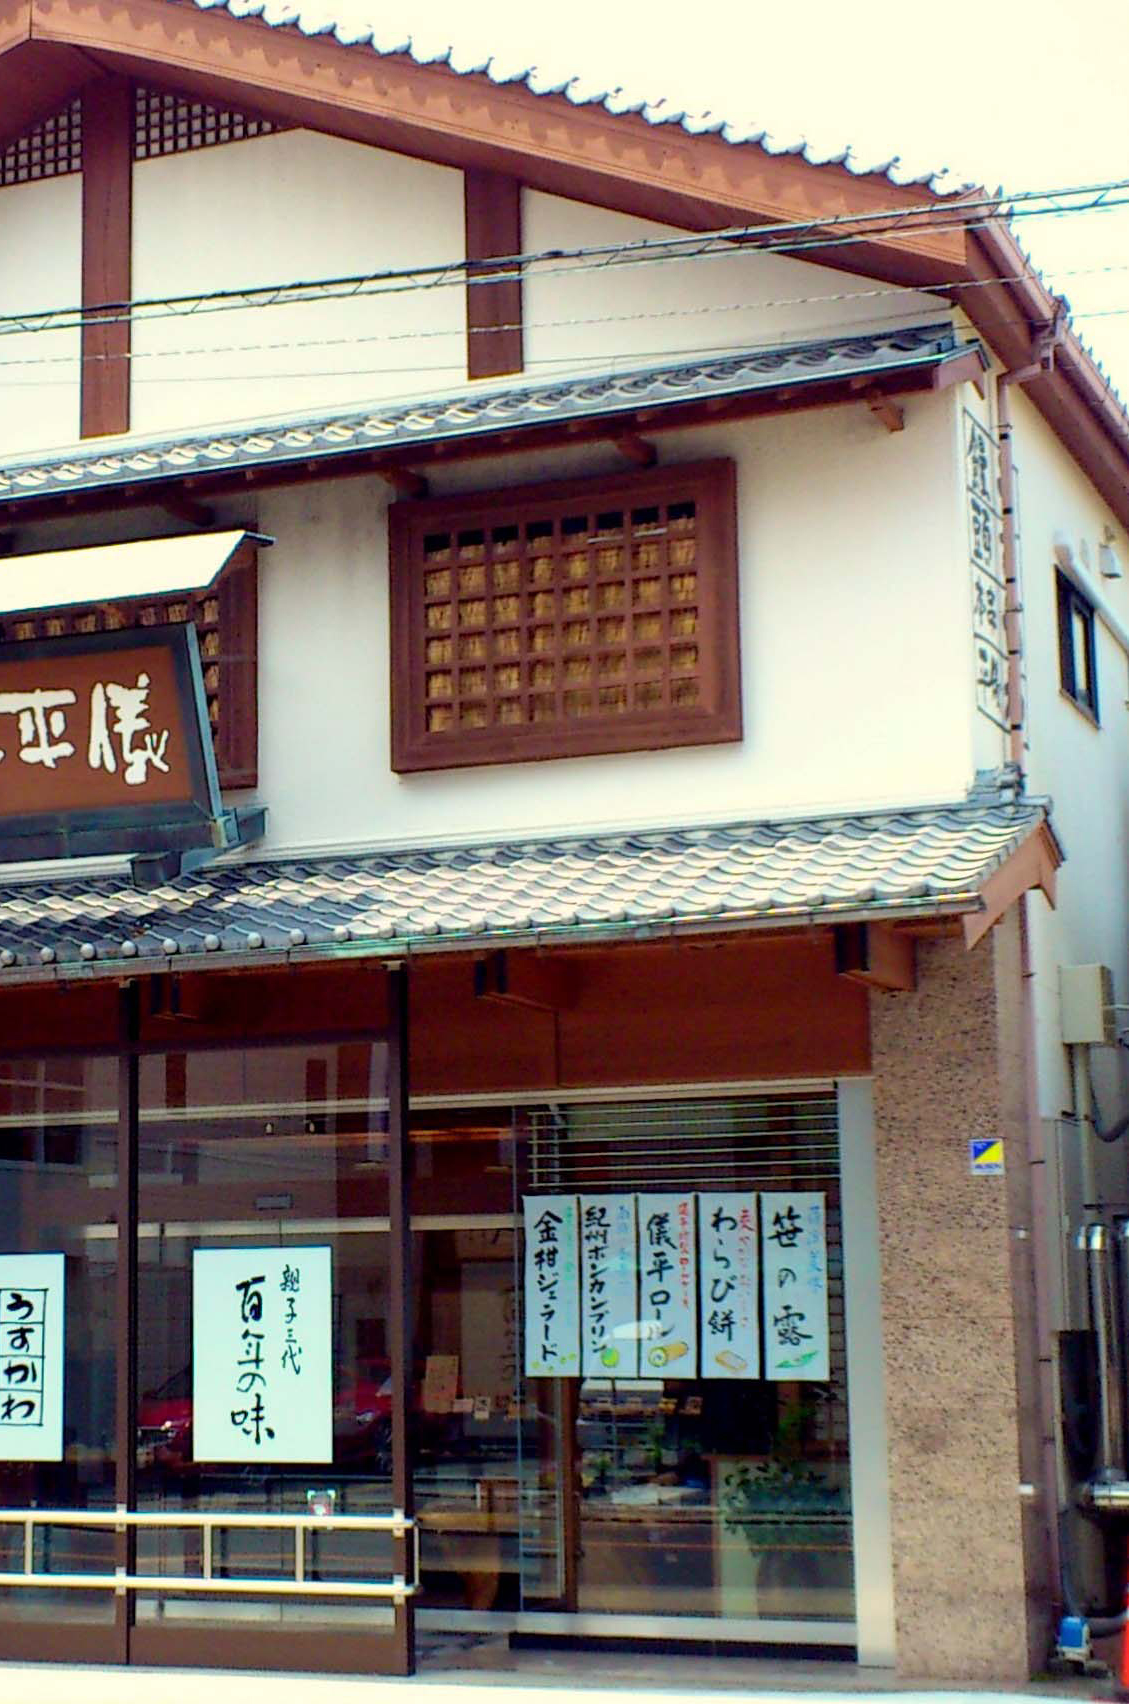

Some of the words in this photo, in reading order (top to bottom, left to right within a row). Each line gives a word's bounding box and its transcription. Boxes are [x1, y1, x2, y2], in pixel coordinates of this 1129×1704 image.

[279, 1263, 302, 1376] 親子三代
[707, 1206, 738, 1342] わらび餅
[1, 1292, 37, 1420] うすかわ
[230, 1275, 275, 1445] 百年の味
